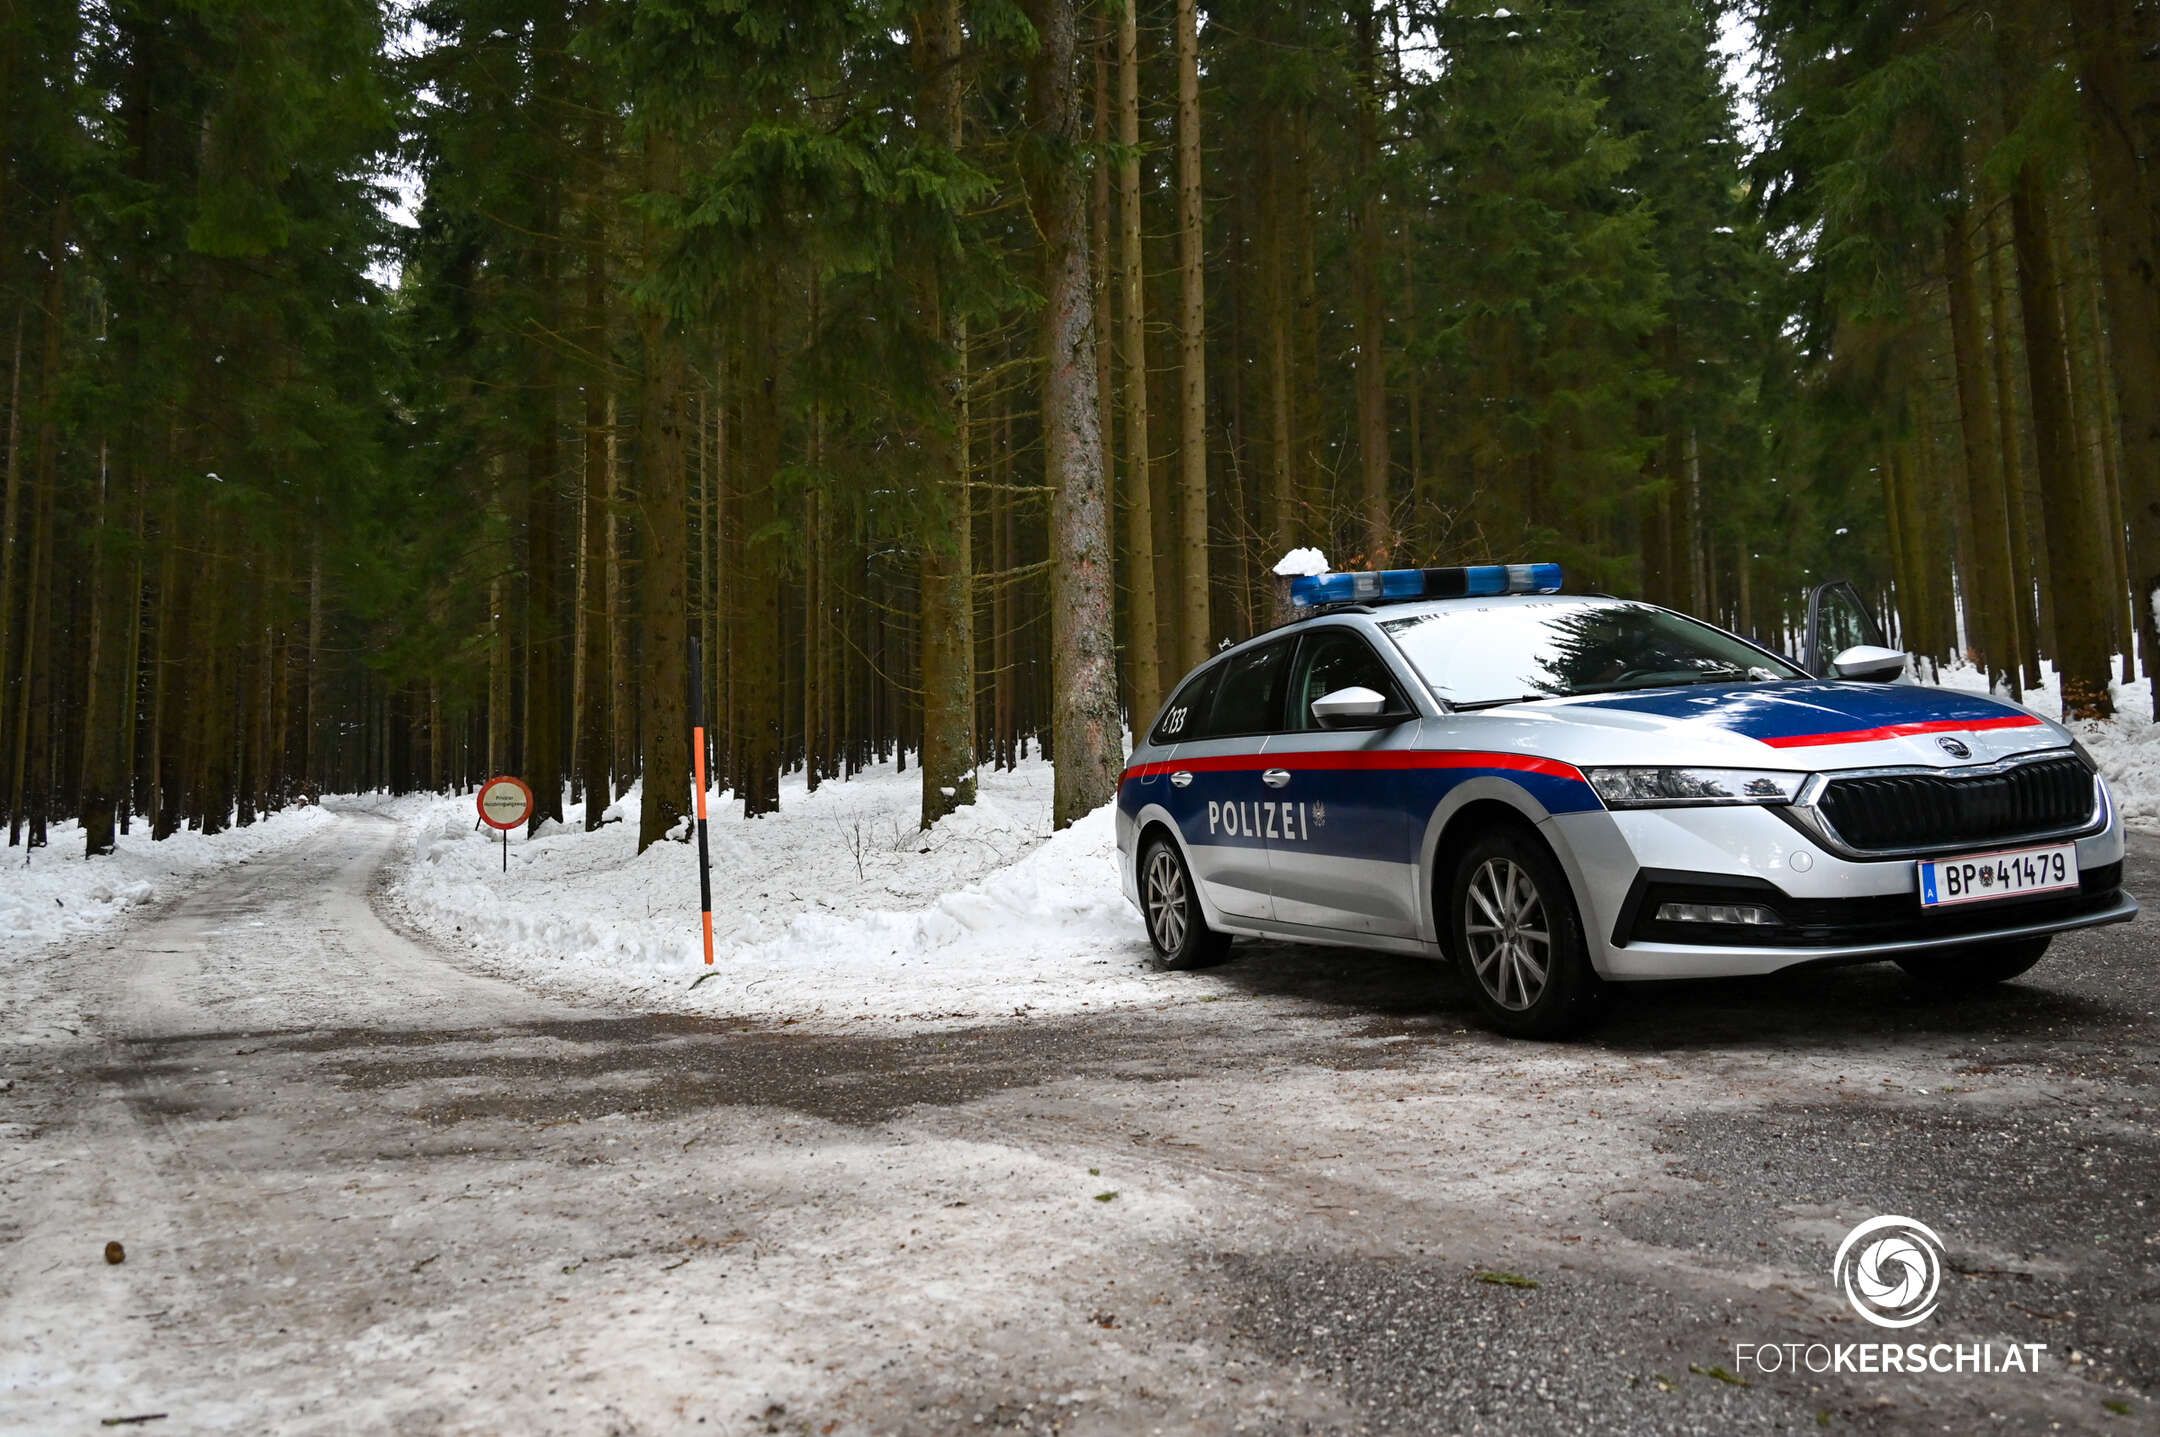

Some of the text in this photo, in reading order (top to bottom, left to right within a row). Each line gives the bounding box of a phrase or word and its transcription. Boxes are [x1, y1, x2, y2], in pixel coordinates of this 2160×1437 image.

[1168, 706, 1188, 734] 133
[1208, 800, 1308, 841] POLIZEI
[1946, 852, 2067, 896] BP 41479
[1926, 888, 1935, 898] A
